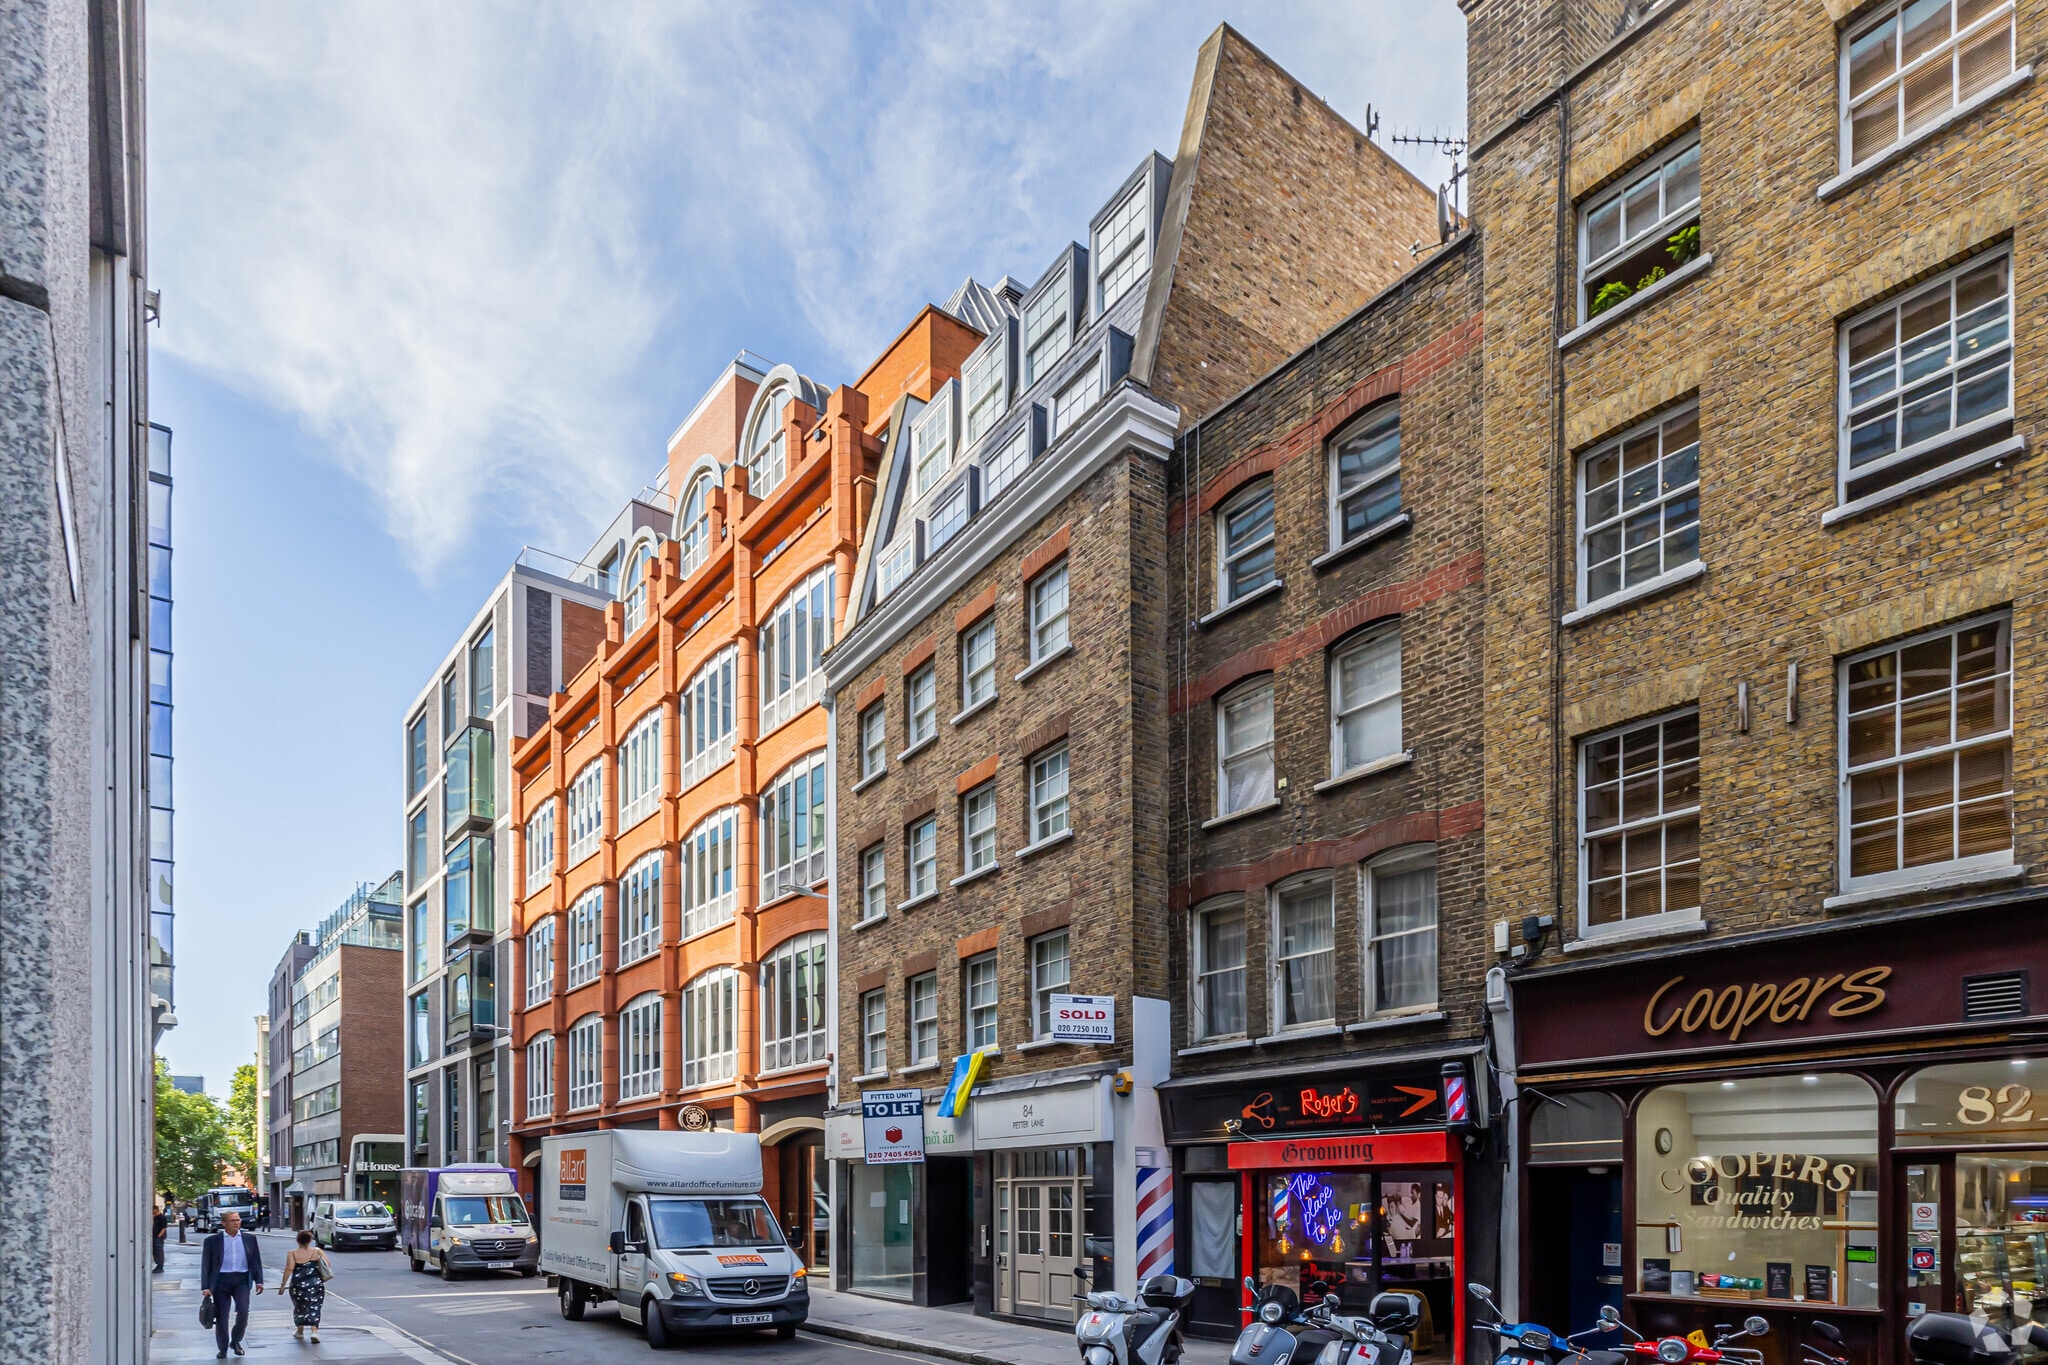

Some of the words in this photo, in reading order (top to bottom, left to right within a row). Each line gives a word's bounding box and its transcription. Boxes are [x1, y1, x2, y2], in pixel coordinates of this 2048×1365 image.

[1644, 966, 1892, 1041] Coopers
[1059, 1010, 1106, 1020] SOLD
[865, 1104, 888, 1116] TO
[892, 1102, 920, 1115] LET
[1022, 1104, 1033, 1117] 84
[1300, 1087, 1358, 1118] Roger's
[1957, 1084, 2034, 1125] 82
[1012, 1120, 1028, 1129] FETTER
[1030, 1118, 1044, 1127] LANE
[1282, 1143, 1374, 1162] Grooming
[561, 1151, 586, 1180] allard
[1658, 1152, 1856, 1194] COOPERS
[1290, 1174, 1316, 1200] The
[1702, 1186, 1794, 1210] Quality
[1304, 1186, 1332, 1236] place
[1326, 1208, 1341, 1229] be
[1683, 1210, 1821, 1230] Sandwiches
[721, 1255, 763, 1264] allard
[1917, 1256, 1930, 1265] LV
[1358, 1345, 1371, 1359] L
